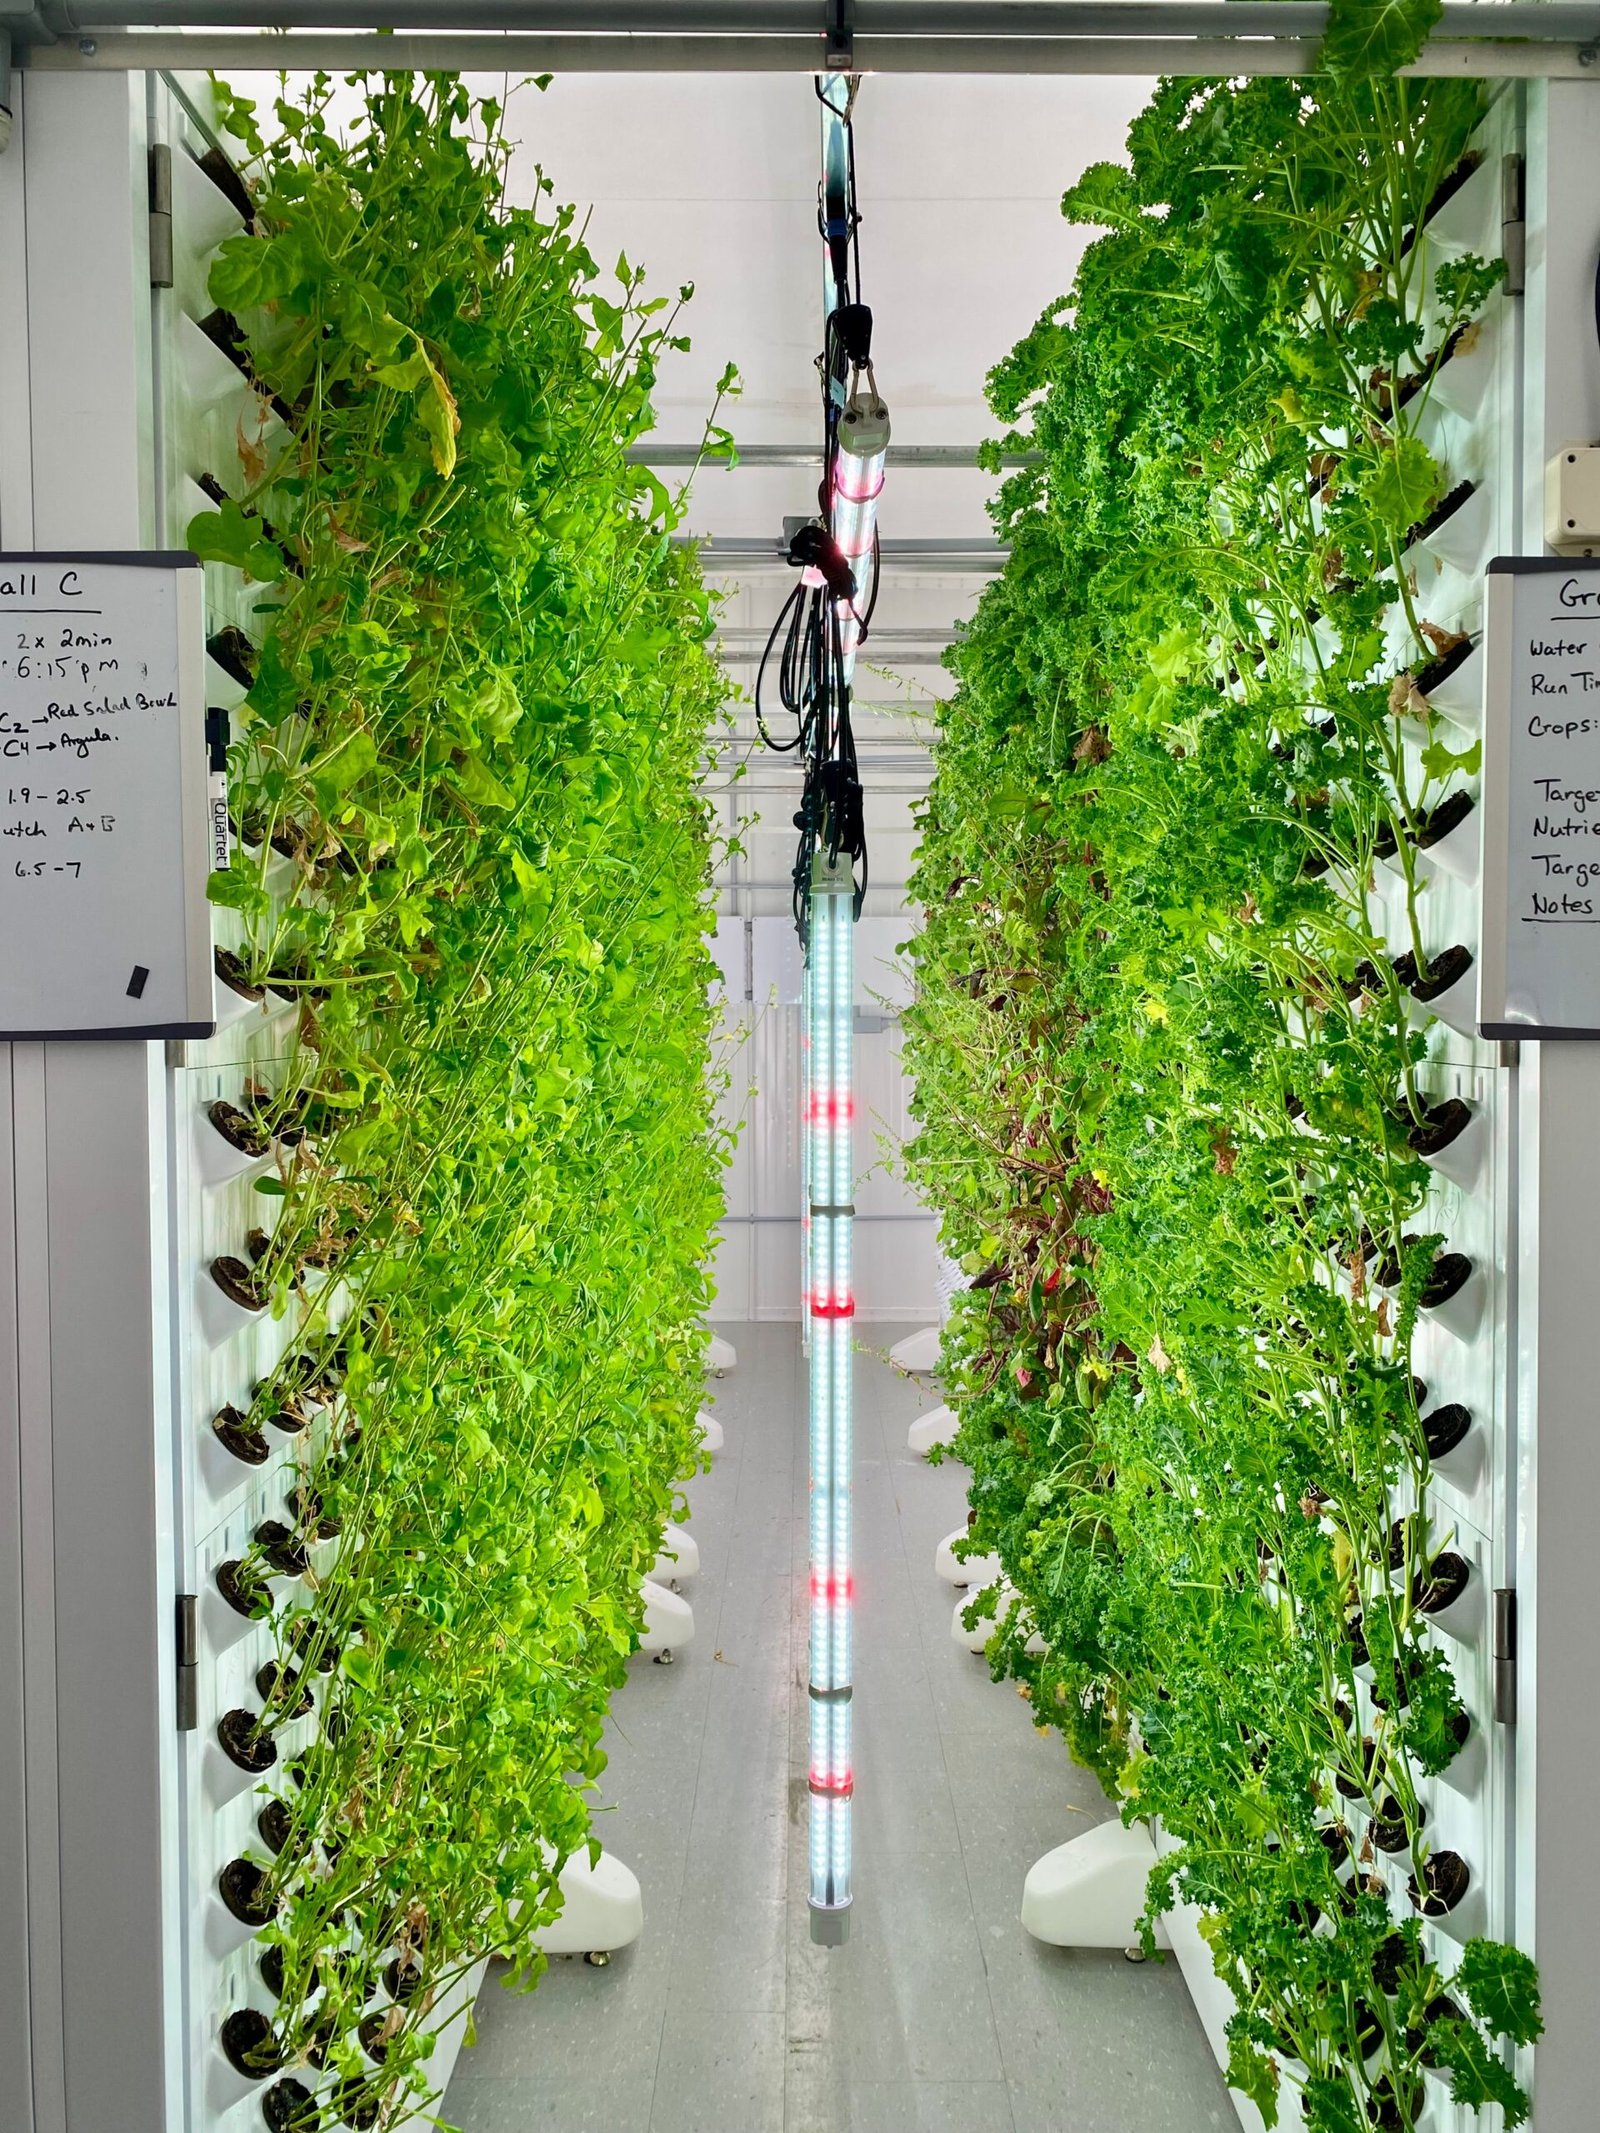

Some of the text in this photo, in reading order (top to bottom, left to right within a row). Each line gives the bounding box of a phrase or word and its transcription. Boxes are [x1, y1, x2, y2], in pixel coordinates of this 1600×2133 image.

[58, 570, 83, 596] C
[1529, 639, 1588, 657] Water
[1530, 673, 1568, 696] Run
[45, 702, 80, 721] Red
[1527, 715, 1599, 740] Crops:
[2, 738, 30, 758] C4
[211, 800, 230, 863] Quartet
[1531, 892, 1594, 916] Notes
